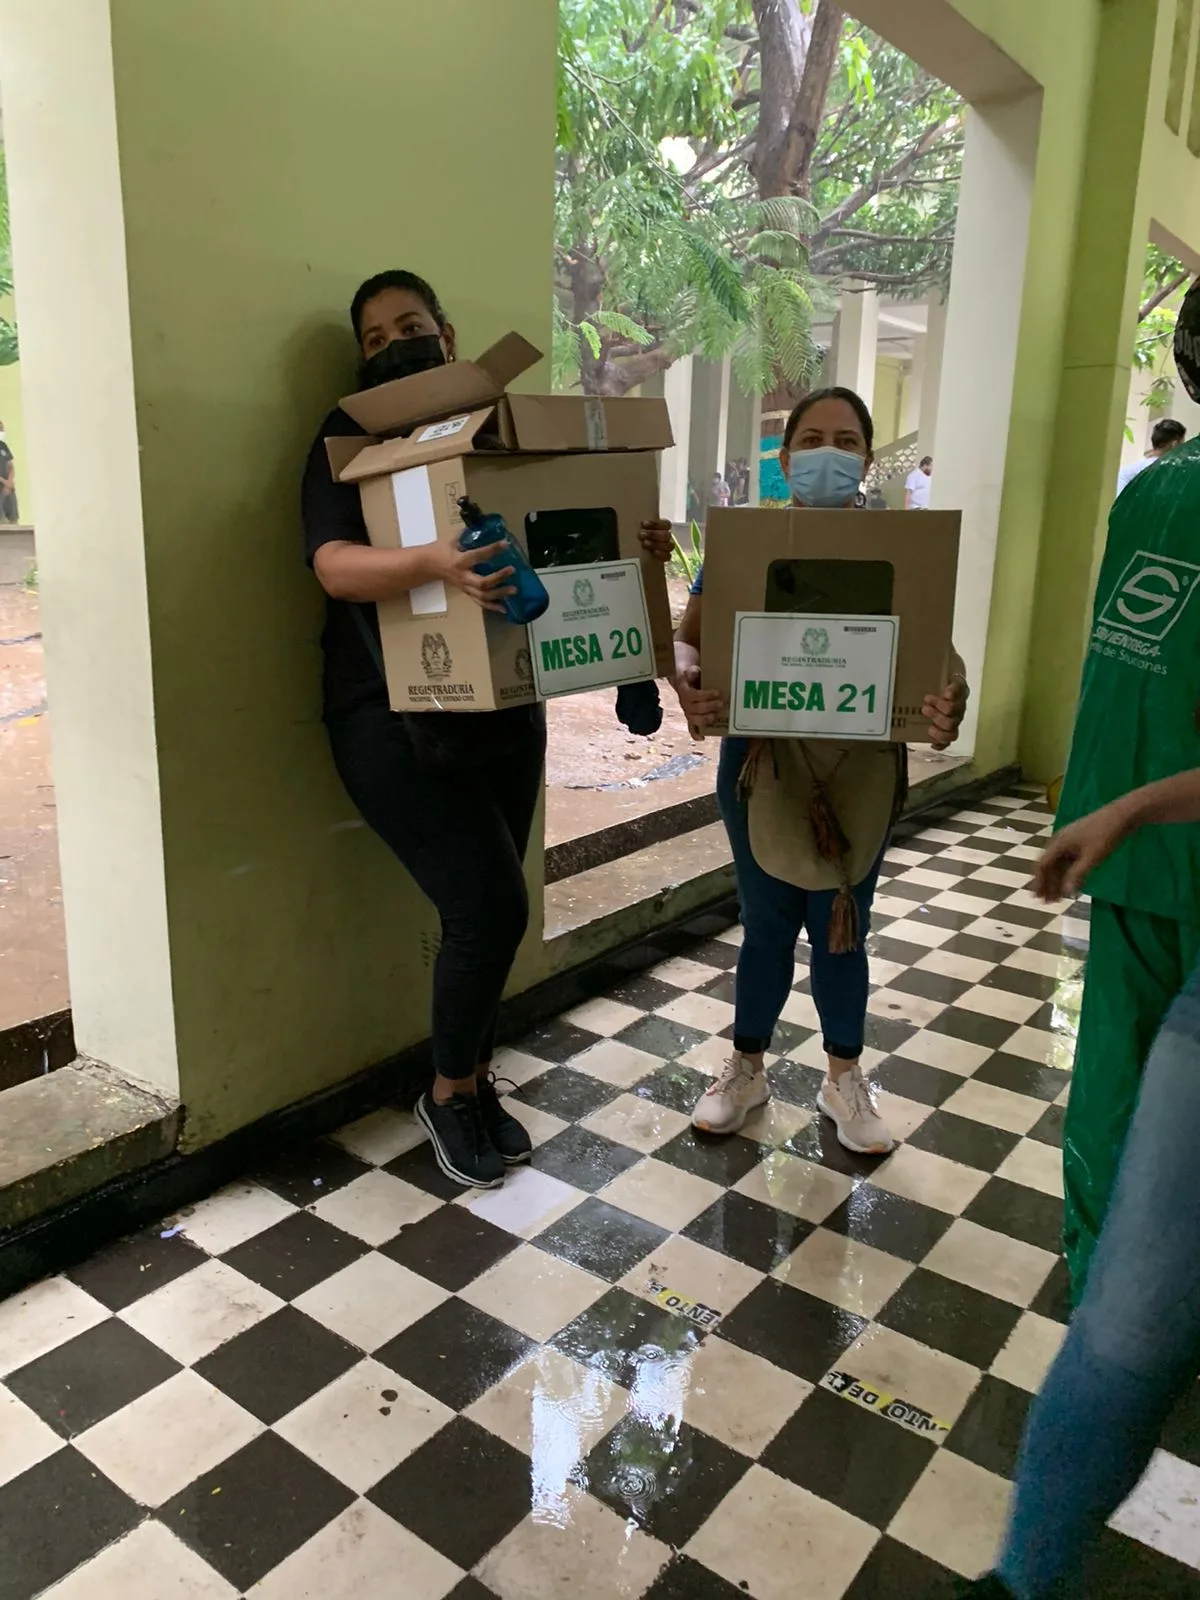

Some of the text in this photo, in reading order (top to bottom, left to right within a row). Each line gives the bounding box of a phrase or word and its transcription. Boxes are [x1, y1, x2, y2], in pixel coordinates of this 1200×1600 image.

[541, 633, 604, 672] MESA
[609, 626, 643, 659] 20
[743, 680, 877, 713] MESA 21
[847, 1385, 949, 1431] NTO DE
